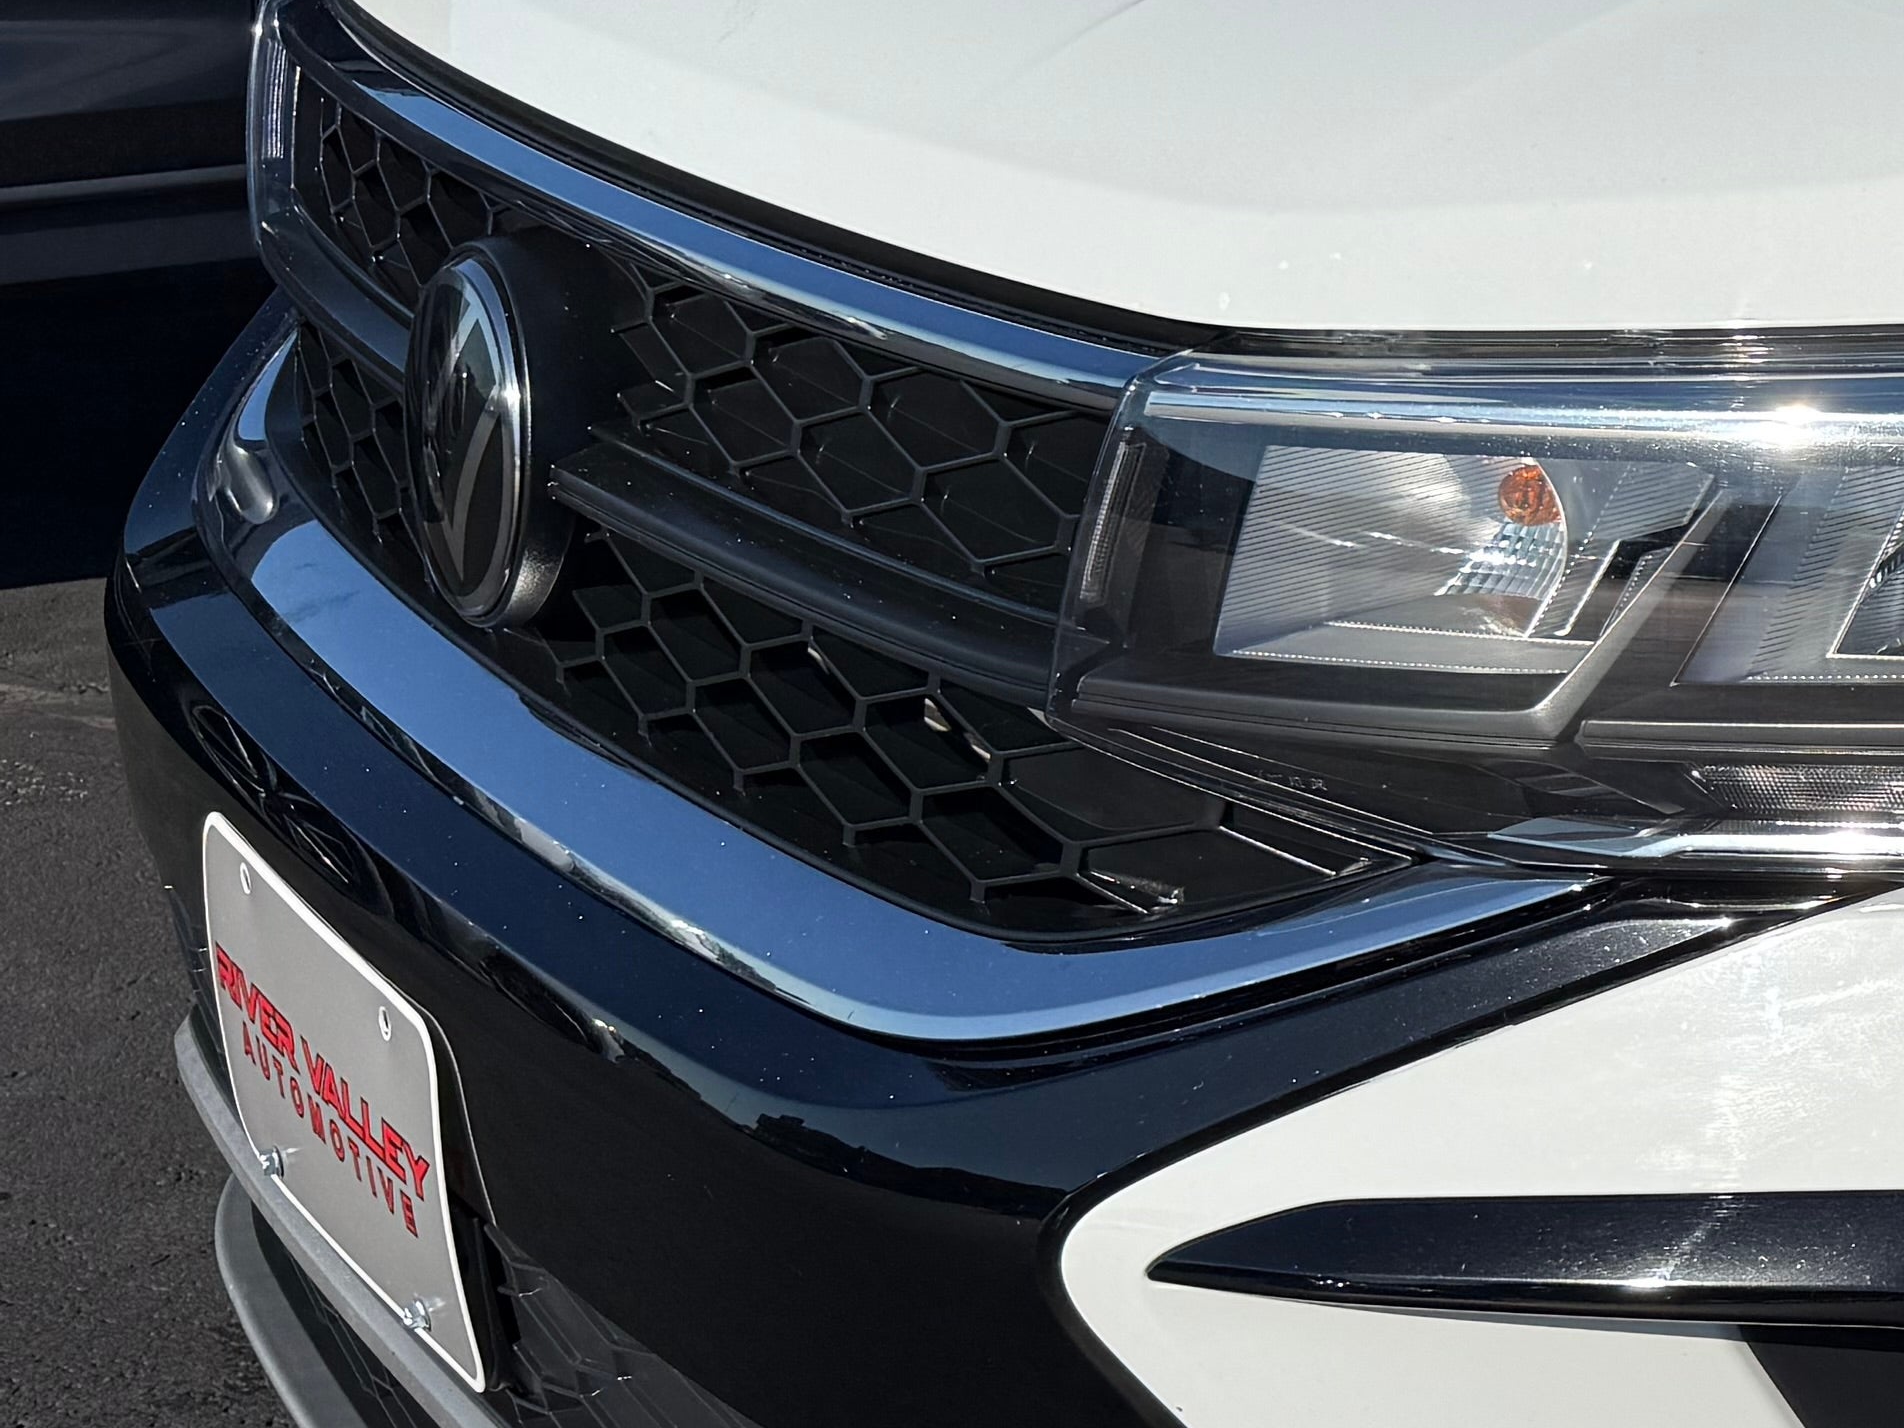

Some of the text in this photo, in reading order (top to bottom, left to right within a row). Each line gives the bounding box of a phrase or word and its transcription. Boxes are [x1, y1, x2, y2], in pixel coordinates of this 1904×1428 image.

[214, 940, 431, 1202] RIVER VALLEY
[241, 1020, 419, 1239] AUTOMOTIVE
